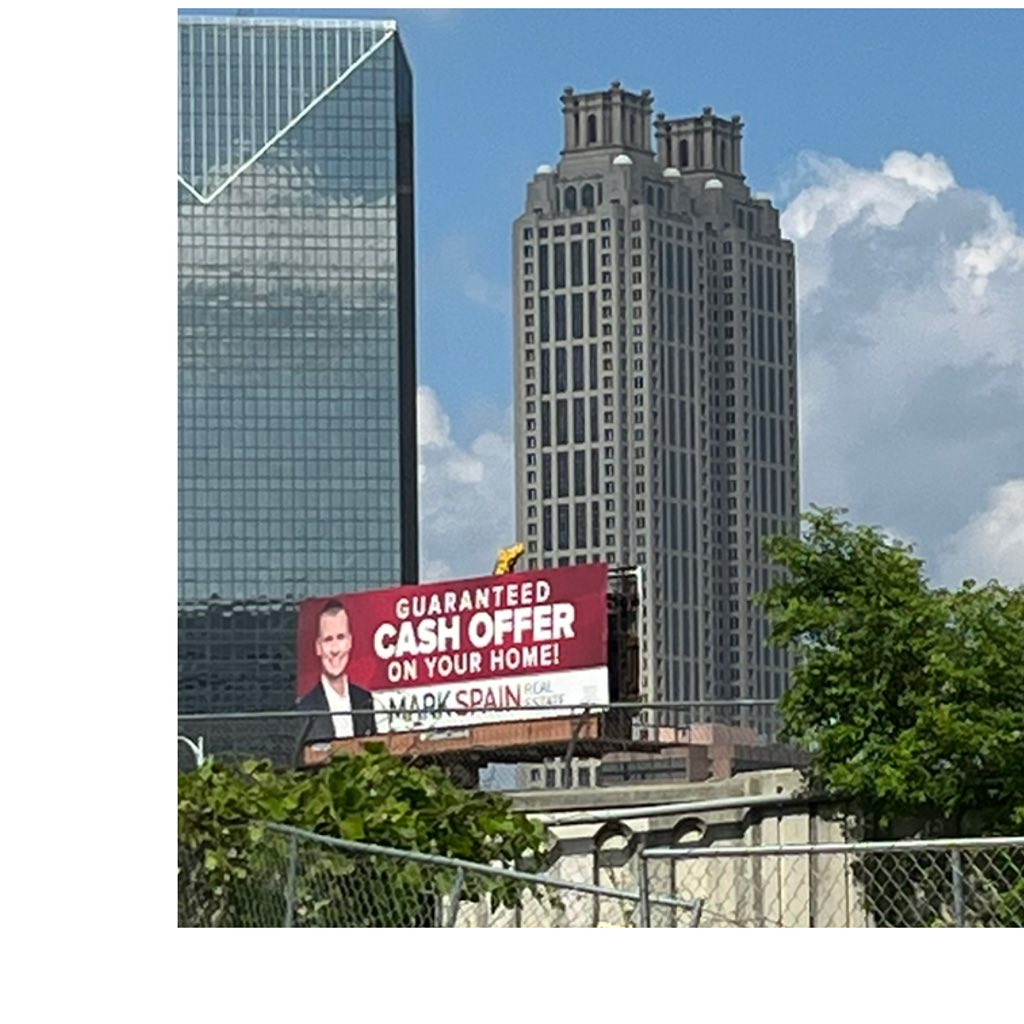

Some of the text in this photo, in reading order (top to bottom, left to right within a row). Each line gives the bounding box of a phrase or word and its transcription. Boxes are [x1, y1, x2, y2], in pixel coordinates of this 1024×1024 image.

[396, 580, 550, 617] GUARANTEED
[374, 603, 575, 659] CASH OFFER
[387, 644, 559, 682] ON YOUR HOME!
[389, 684, 521, 722] MARK SPAIN
